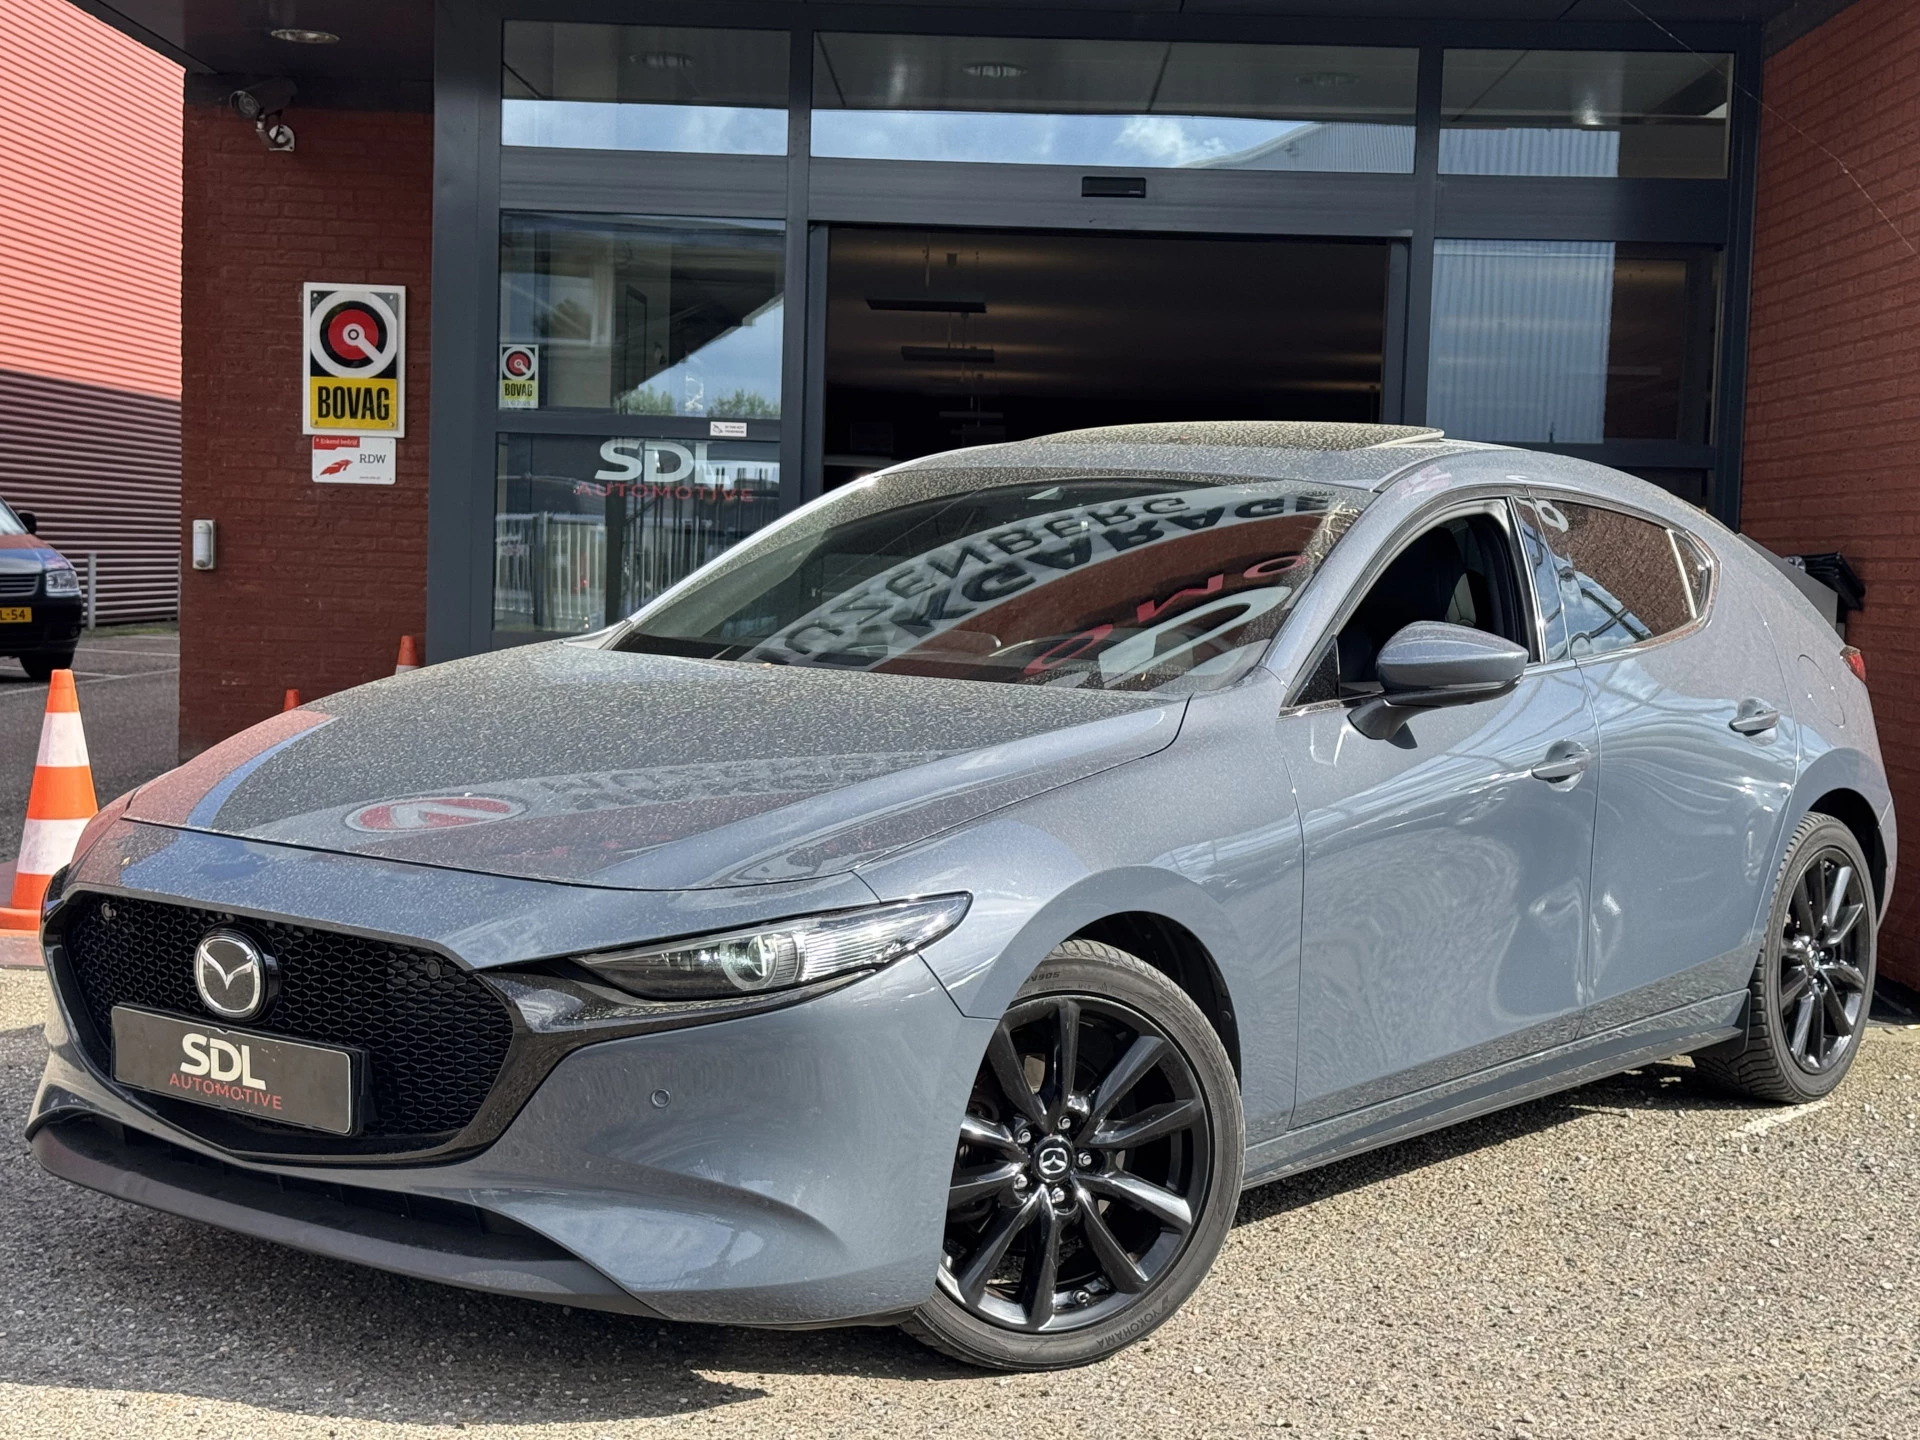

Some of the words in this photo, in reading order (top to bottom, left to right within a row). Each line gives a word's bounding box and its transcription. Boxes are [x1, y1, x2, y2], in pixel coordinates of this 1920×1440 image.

[317, 385, 390, 421] BOVAG
[504, 383, 533, 397] BOVAG
[359, 453, 387, 464] RDW
[594, 438, 731, 485] SDL
[574, 481, 755, 503] AUTOMOTIVE
[179, 1032, 267, 1091] SDL
[168, 1072, 284, 1111] AUTOMOTIVE
[1096, 1308, 1161, 1348] YOKOHAMA
